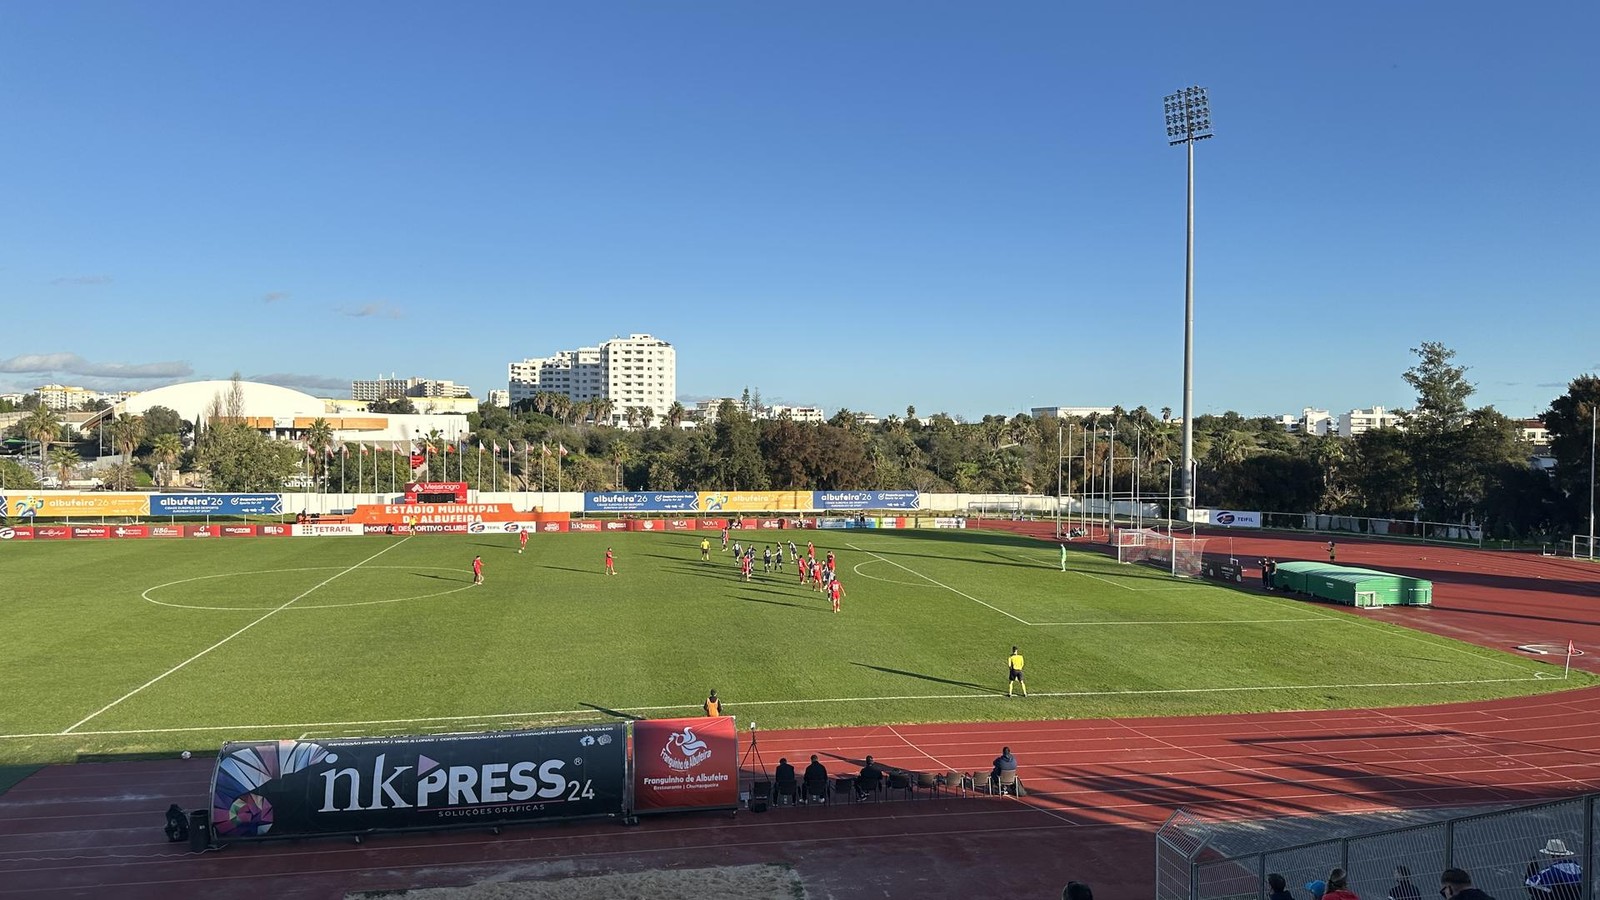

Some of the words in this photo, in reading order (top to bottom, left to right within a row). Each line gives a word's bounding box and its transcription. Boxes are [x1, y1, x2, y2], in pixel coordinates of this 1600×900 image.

[160, 497, 223, 506] albufeira'26
[385, 504, 434, 514] ESTÁDIO
[438, 504, 499, 513] MUNICIPAL
[421, 514, 483, 523] ALBUFEIRA
[660, 747, 684, 769] Franguinho
[684, 758, 690, 769] de
[690, 749, 712, 768] Albufeira
[644, 775, 684, 785] Franguinho
[685, 774, 694, 783] de
[696, 772, 729, 782] Albufeira
[568, 779, 595, 801] 24
[438, 807, 492, 817] SOLUÇÕES
[494, 804, 545, 813] GRÁFICAS
